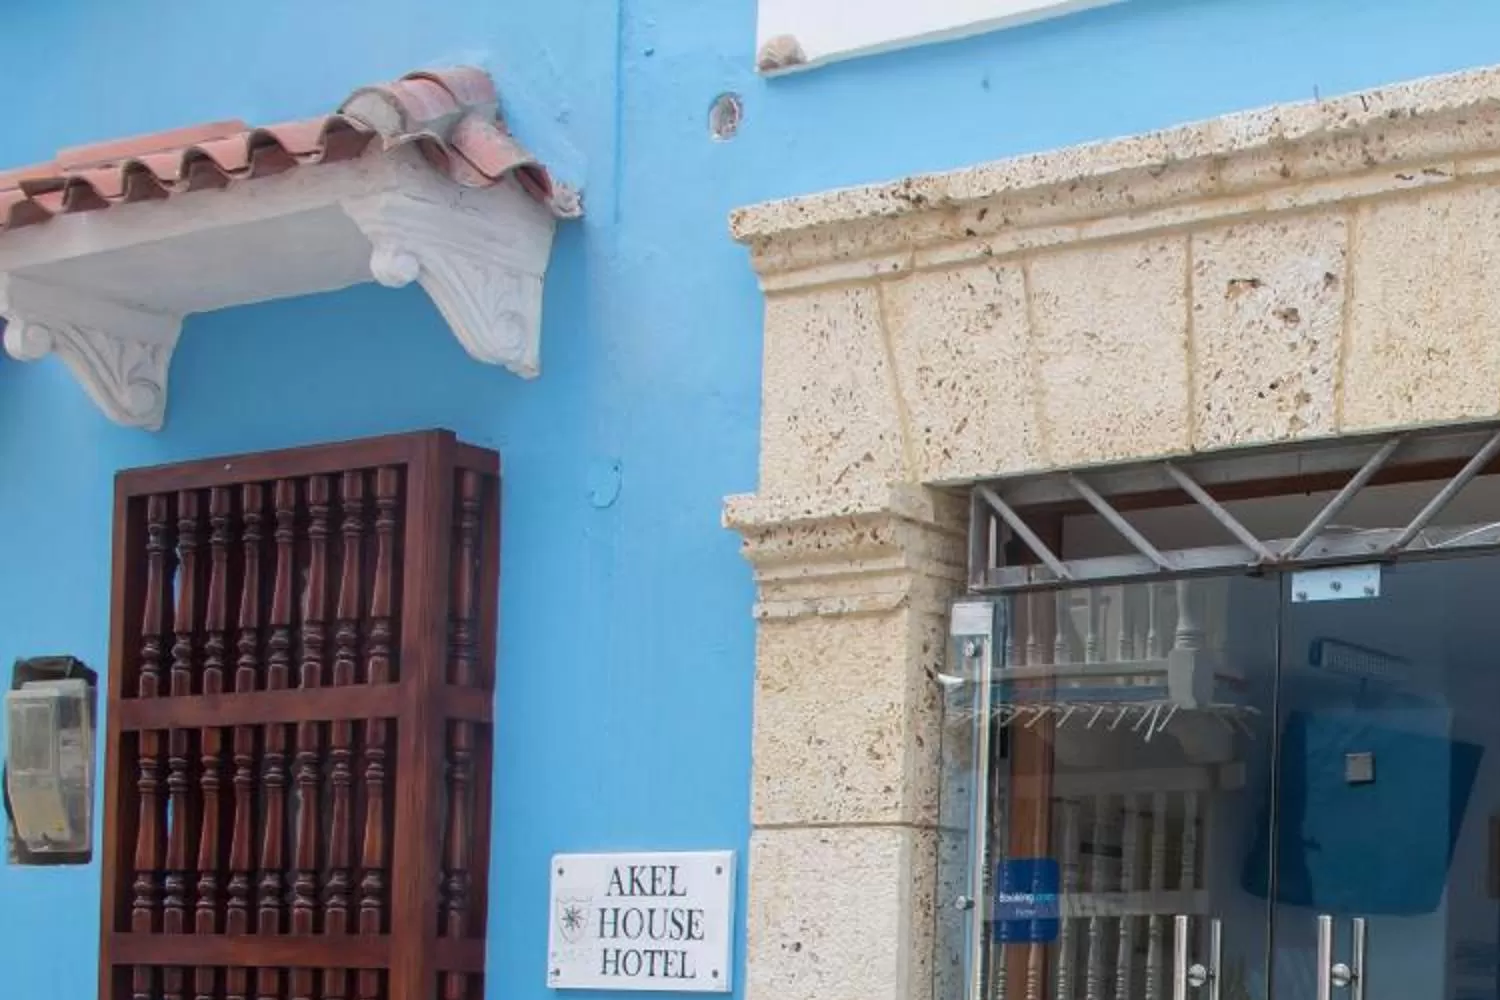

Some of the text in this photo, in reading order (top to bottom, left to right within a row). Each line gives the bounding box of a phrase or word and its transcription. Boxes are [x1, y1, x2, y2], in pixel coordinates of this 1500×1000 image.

[605, 865, 687, 897] AKEL
[598, 907, 705, 941] HOUSE
[600, 948, 697, 979] HOTEL
